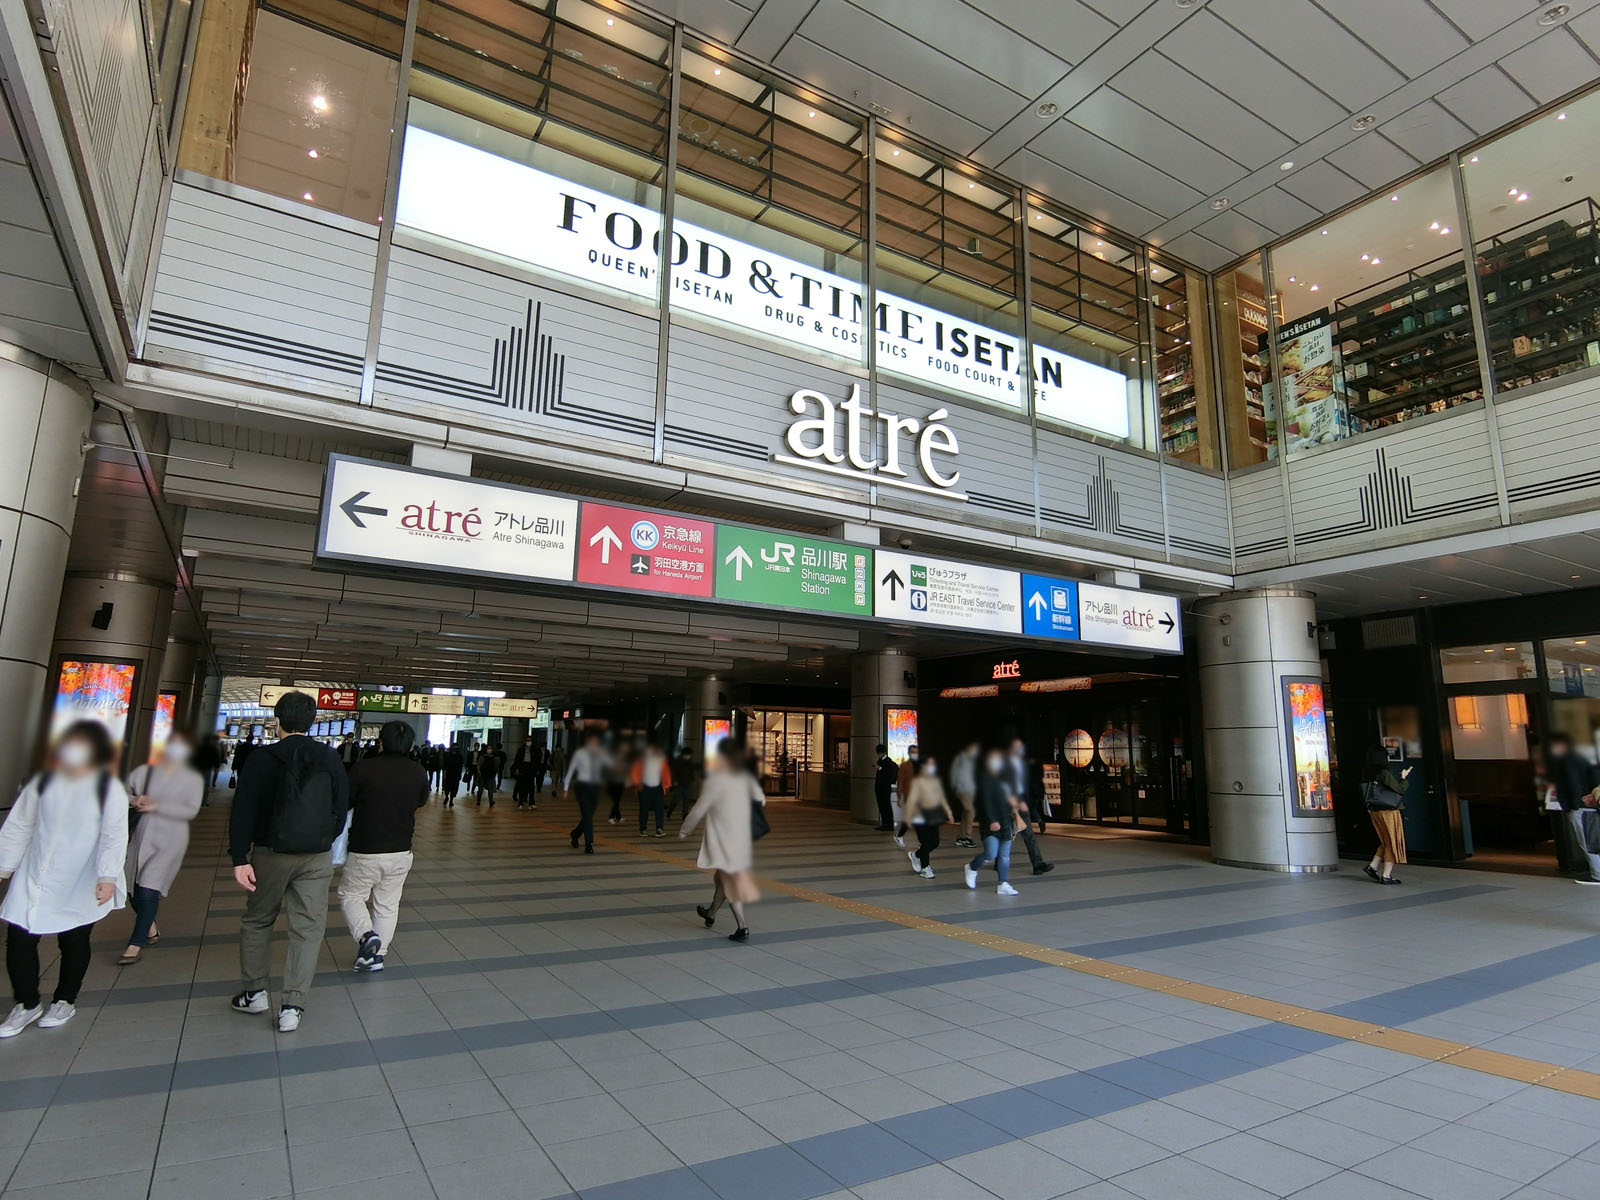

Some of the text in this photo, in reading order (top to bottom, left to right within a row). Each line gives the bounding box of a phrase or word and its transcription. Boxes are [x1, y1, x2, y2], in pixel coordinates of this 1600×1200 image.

[557, 192, 731, 279] FOOD
[749, 260, 783, 299] &
[676, 276, 733, 305] ISETAN
[765, 305, 907, 358] DRUG & COSTICS
[928, 356, 959, 374] FOOD
[965, 368, 1002, 387] COURT
[1008, 381, 1015, 391] &
[784, 383, 959, 487] atré
[400, 500, 482, 537] atré
[494, 511, 565, 537] アトレ品川
[408, 530, 471, 543] SHINAGAWA
[493, 531, 565, 550] Atre Shinagawa
[636, 529, 653, 541] KK
[663, 525, 702, 543] 京急線
[689, 545, 704, 554] Line
[760, 541, 795, 566] JR
[801, 547, 847, 570] 品川駅
[654, 556, 704, 573] 羽田空港方面
[929, 567, 967, 580] びゅうプラザ
[662, 570, 683, 578] Haneda
[684, 572, 702, 581] Airport
[801, 568, 847, 585] Shinagawa
[801, 582, 830, 595] Station
[930, 592, 937, 601] JR
[940, 593, 956, 603] EAST
[958, 595, 974, 606] Travel
[976, 598, 996, 609] Service
[997, 601, 1015, 611] Center
[1085, 600, 1118, 616] アトレ品川
[1122, 606, 1154, 628] atré
[993, 660, 1019, 676] atré
